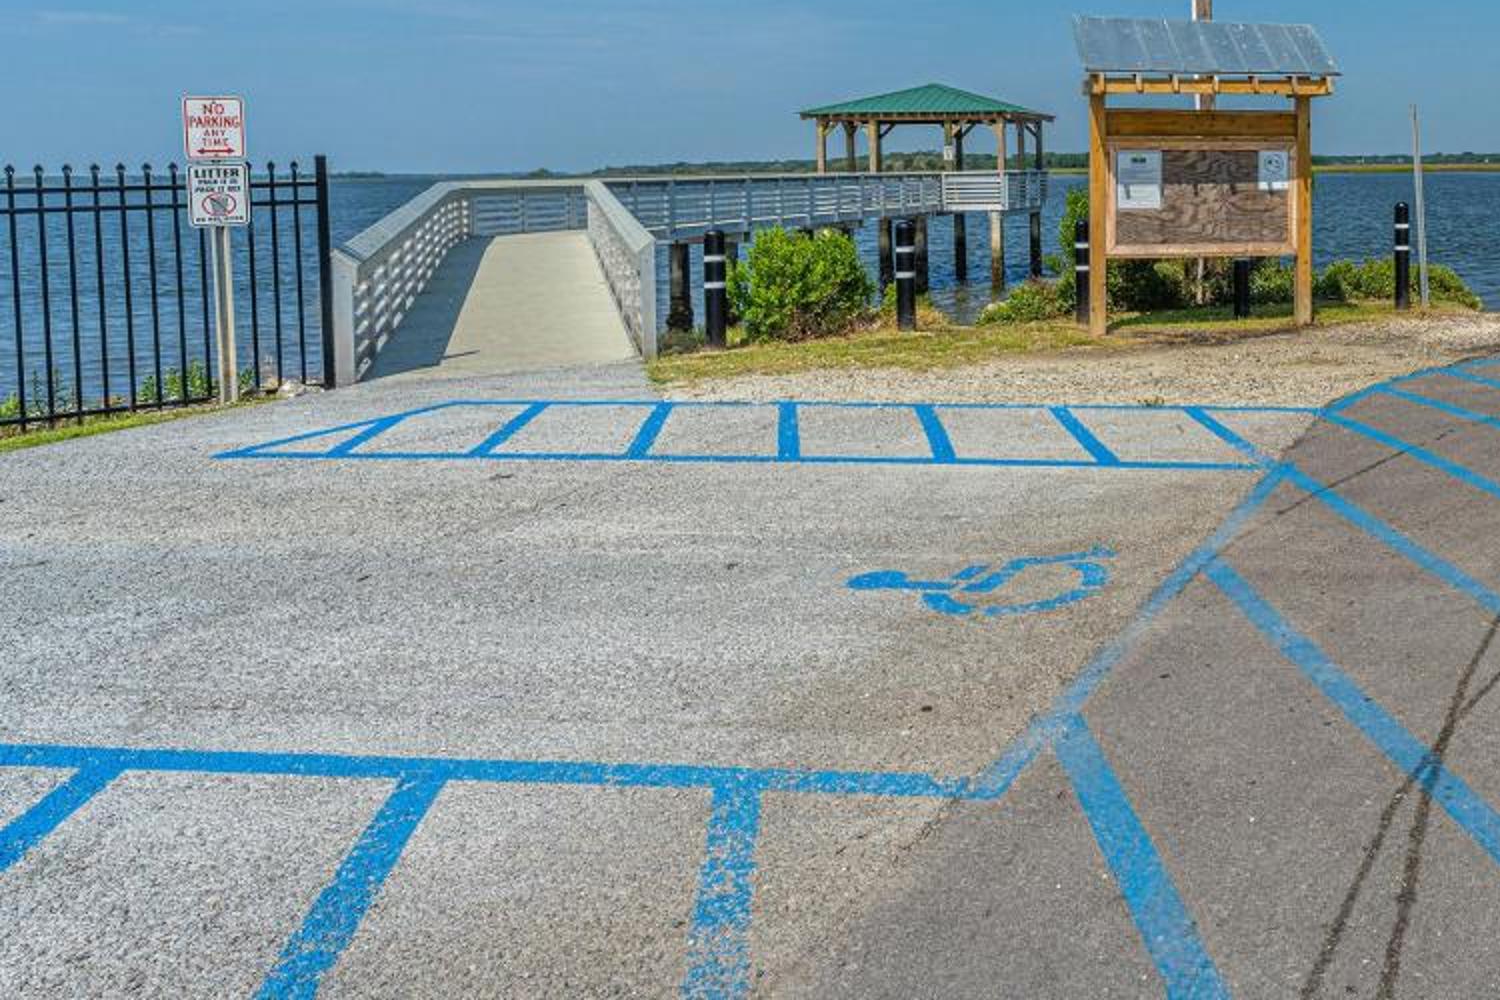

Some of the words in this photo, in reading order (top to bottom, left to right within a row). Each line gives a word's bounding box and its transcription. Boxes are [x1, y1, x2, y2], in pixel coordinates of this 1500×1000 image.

[203, 103, 224, 115] NO
[190, 116, 240, 128] PARKING
[202, 137, 229, 147] TIME
[194, 168, 239, 179] LITTER
